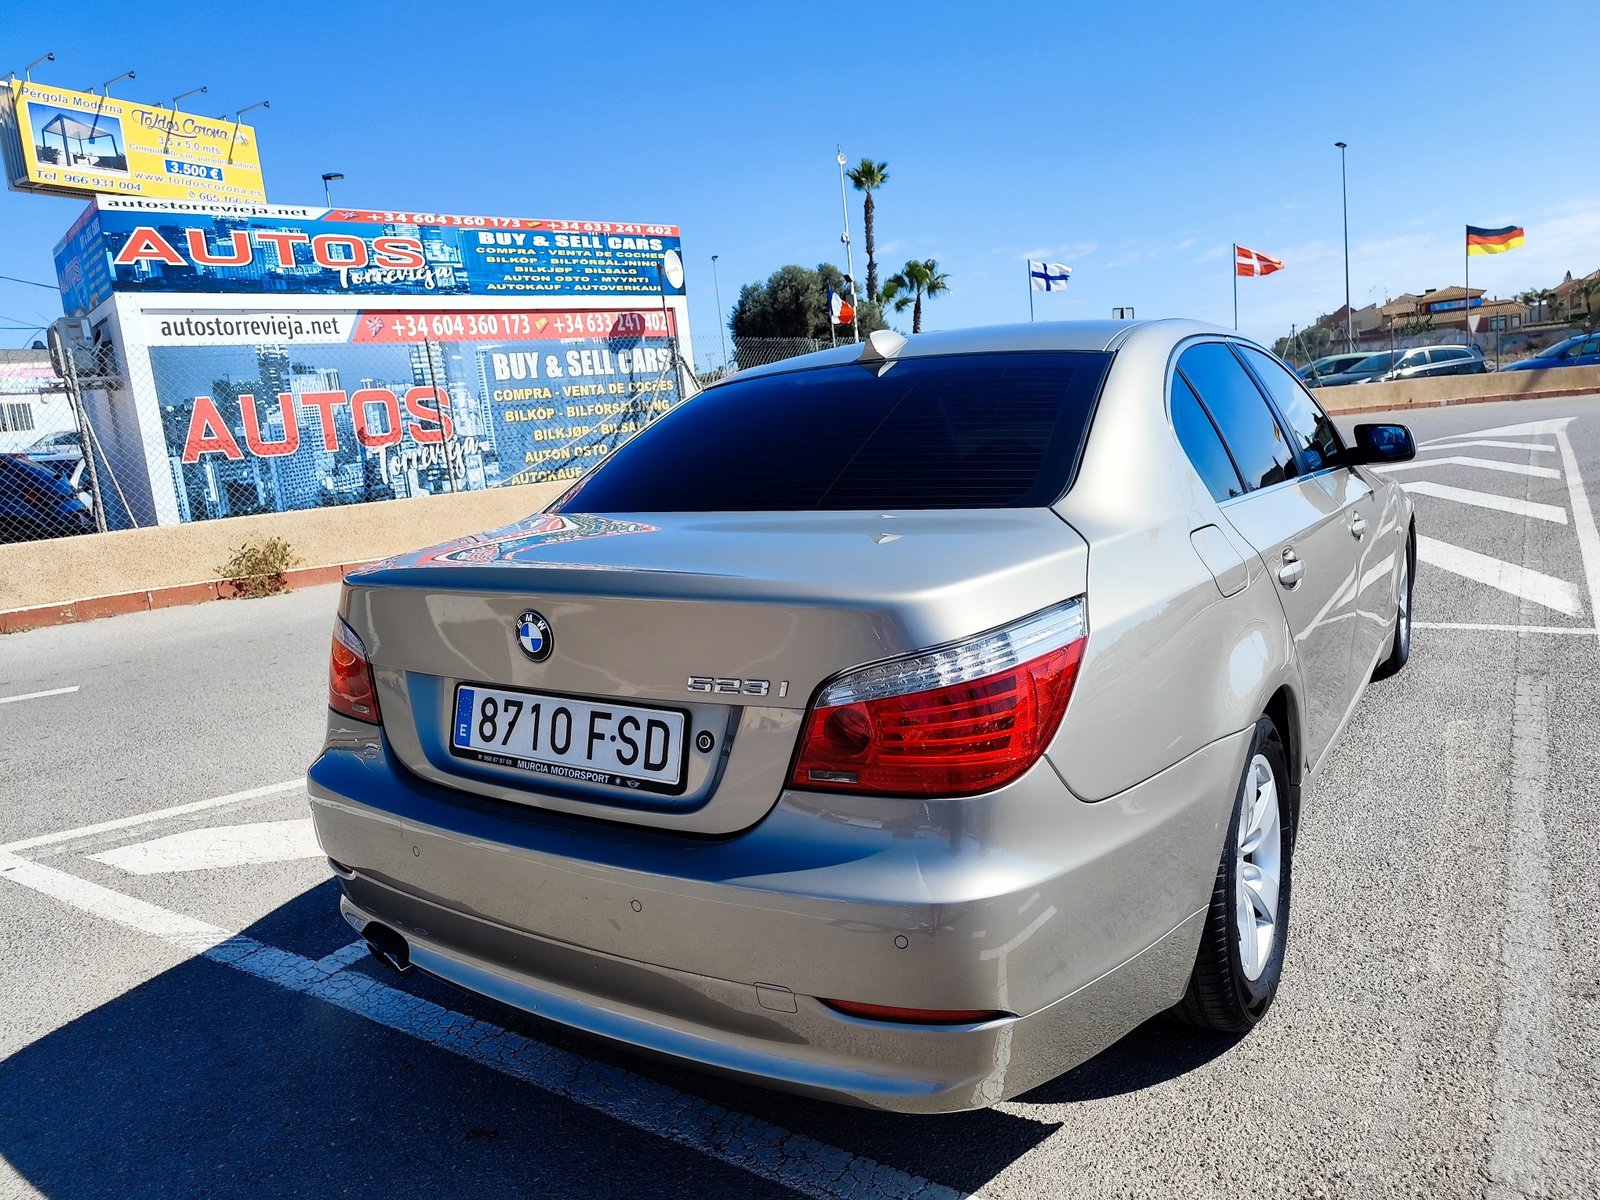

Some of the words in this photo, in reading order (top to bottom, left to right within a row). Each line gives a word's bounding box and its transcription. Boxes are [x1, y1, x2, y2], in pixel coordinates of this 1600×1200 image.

[22, 86, 69, 104] Pérgola
[73, 97, 123, 114] Moderna
[131, 109, 180, 132] Toldos
[183, 118, 229, 140] Corona
[158, 136, 174, 146] 35
[35, 169, 60, 181] Tel.
[64, 173, 89, 185] 966
[92, 178, 115, 188] 931
[119, 181, 142, 191] 004
[170, 161, 208, 178] 3.500
[210, 168, 219, 180] €
[199, 192, 220, 202] 665
[107, 198, 310, 217] autostorrevieja.net
[366, 211, 408, 223] +34
[413, 213, 448, 225] 604
[452, 215, 486, 226] 360
[491, 217, 522, 228] 173
[547, 221, 581, 231] +34
[584, 222, 612, 232] 633
[615, 224, 642, 234] 241
[646, 226, 673, 235] 402
[114, 226, 426, 270] AUTOS
[478, 230, 527, 247] BUY
[532, 235, 550, 247] &
[555, 234, 604, 249] SELL
[608, 236, 663, 251] CARS
[475, 247, 537, 256] COMPRA
[548, 249, 592, 257] VENTA
[486, 256, 538, 265] BILKÖP
[334, 265, 452, 291] Torrevieja
[503, 274, 551, 282] AUTON
[555, 275, 590, 283] OSTO
[584, 267, 638, 275] BILSALG
[486, 283, 562, 291] AUTOKAUF
[160, 315, 341, 340] autostorrevieja.net
[391, 314, 429, 337] +34
[432, 314, 465, 336] 604
[467, 314, 499, 335] 360
[501, 314, 531, 335] 173
[553, 314, 584, 334] +34
[586, 313, 613, 333] 633
[617, 313, 641, 331] 241
[645, 313, 668, 331] 402
[492, 351, 540, 381] BUY
[545, 353, 564, 378] &
[566, 349, 615, 377] SELL
[617, 347, 672, 374] CARS
[493, 387, 552, 402] COMPRA
[562, 383, 606, 398] VENTA
[608, 382, 625, 394] DE
[505, 406, 555, 422] BILKÖP
[182, 385, 455, 464] AUTOS
[525, 447, 571, 463] AUTON
[574, 443, 608, 457] OSTO
[516, 613, 547, 631] BMW
[460, 723, 468, 737] E
[478, 696, 573, 755] 8710
[587, 710, 671, 772] FSD
[517, 759, 549, 773] MURCIA
[550, 767, 610, 784] MOTORSPORT
